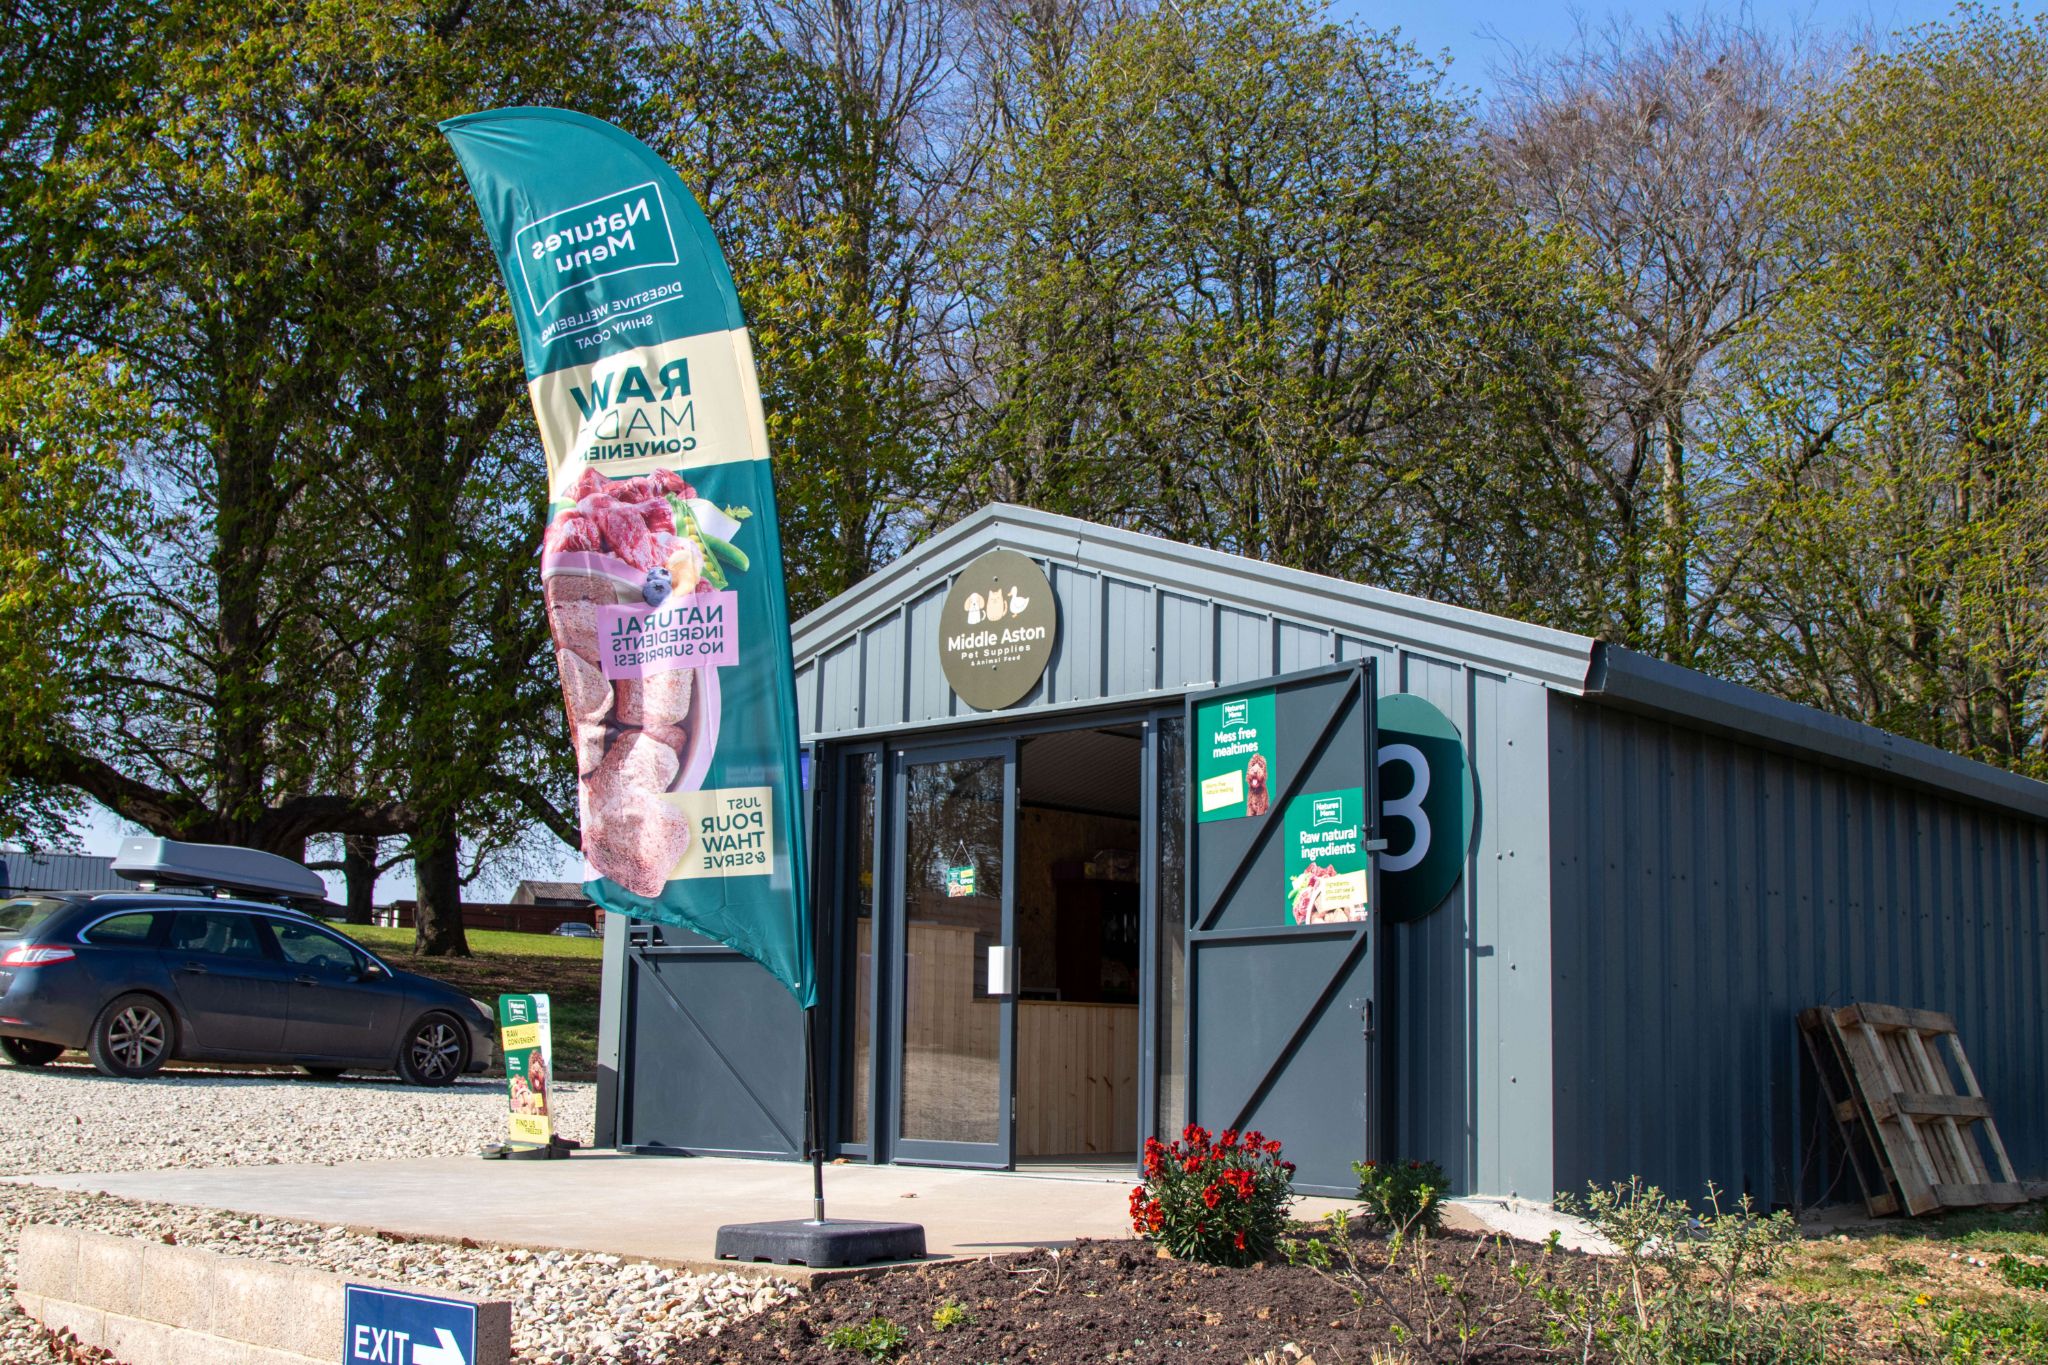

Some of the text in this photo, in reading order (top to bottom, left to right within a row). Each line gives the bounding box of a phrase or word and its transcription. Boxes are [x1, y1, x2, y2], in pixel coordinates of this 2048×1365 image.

[948, 626, 1046, 651] Middle Aston
[961, 644, 1031, 660] Pet Supplies
[977, 658, 1001, 666] Animal
[1214, 727, 1257, 745] Mess free
[1213, 741, 1259, 758] mealtimes
[1377, 743, 1432, 873] 3
[1300, 824, 1357, 844] Raw natural
[1301, 842, 1356, 861] ingredients
[355, 1324, 410, 1365] EXIT
